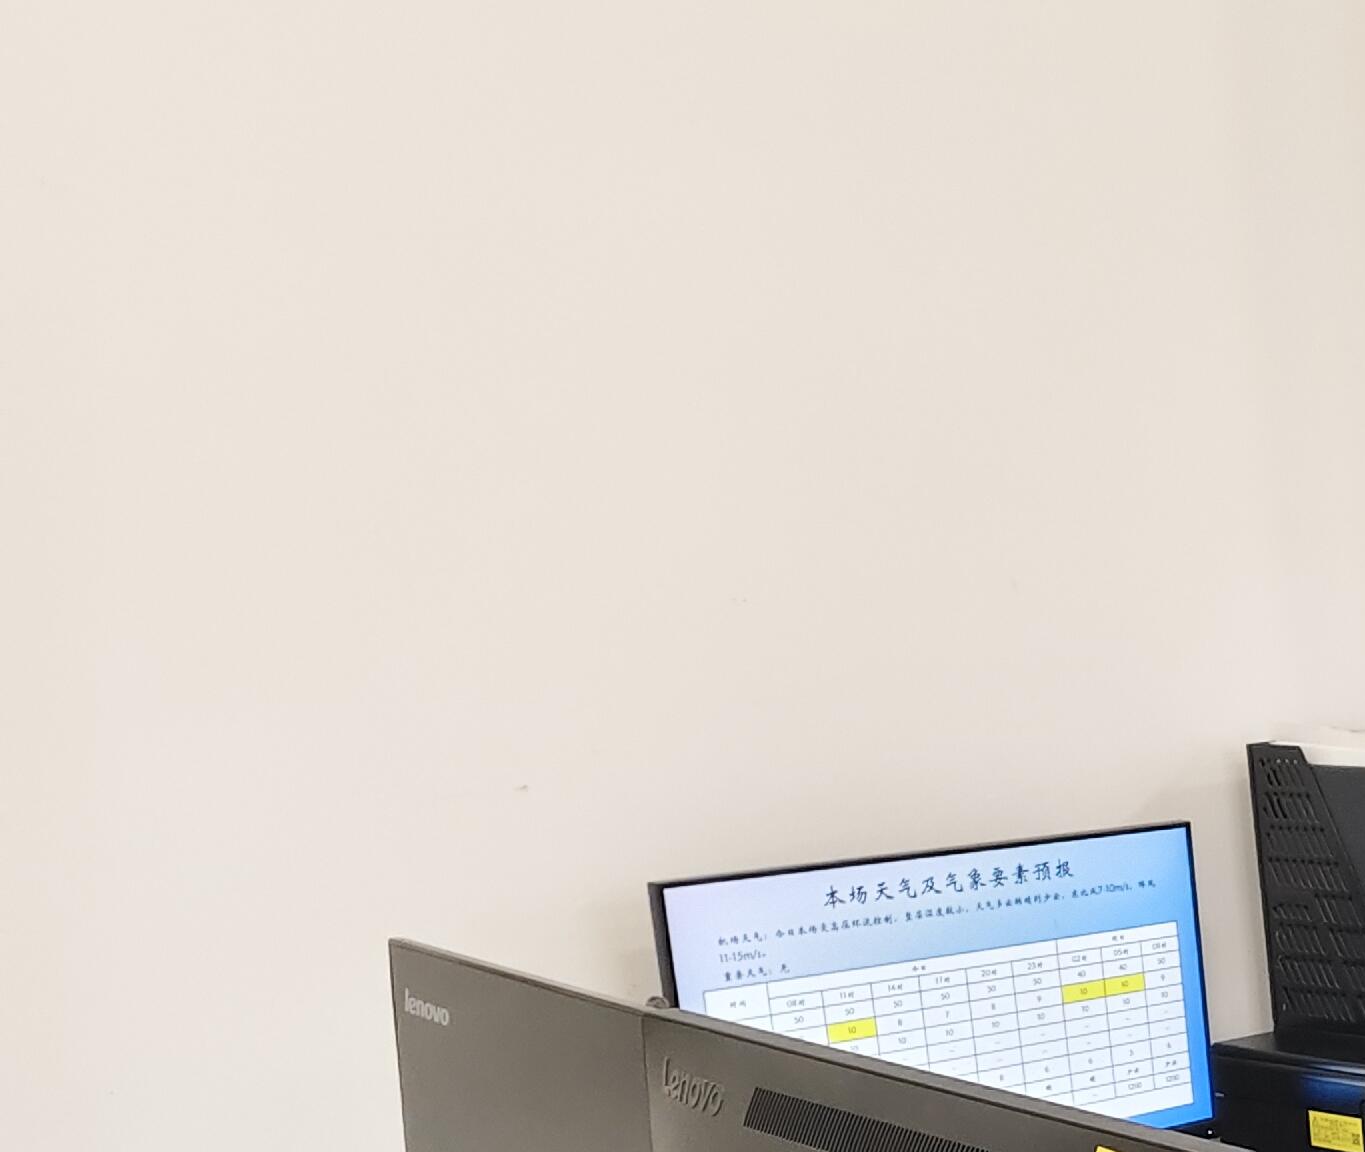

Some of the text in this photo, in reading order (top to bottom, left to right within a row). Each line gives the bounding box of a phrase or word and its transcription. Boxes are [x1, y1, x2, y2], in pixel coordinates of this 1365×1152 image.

[824, 859, 1074, 909] 本场天气及气象要素预报
[662, 1055, 724, 1117] Lenovo
